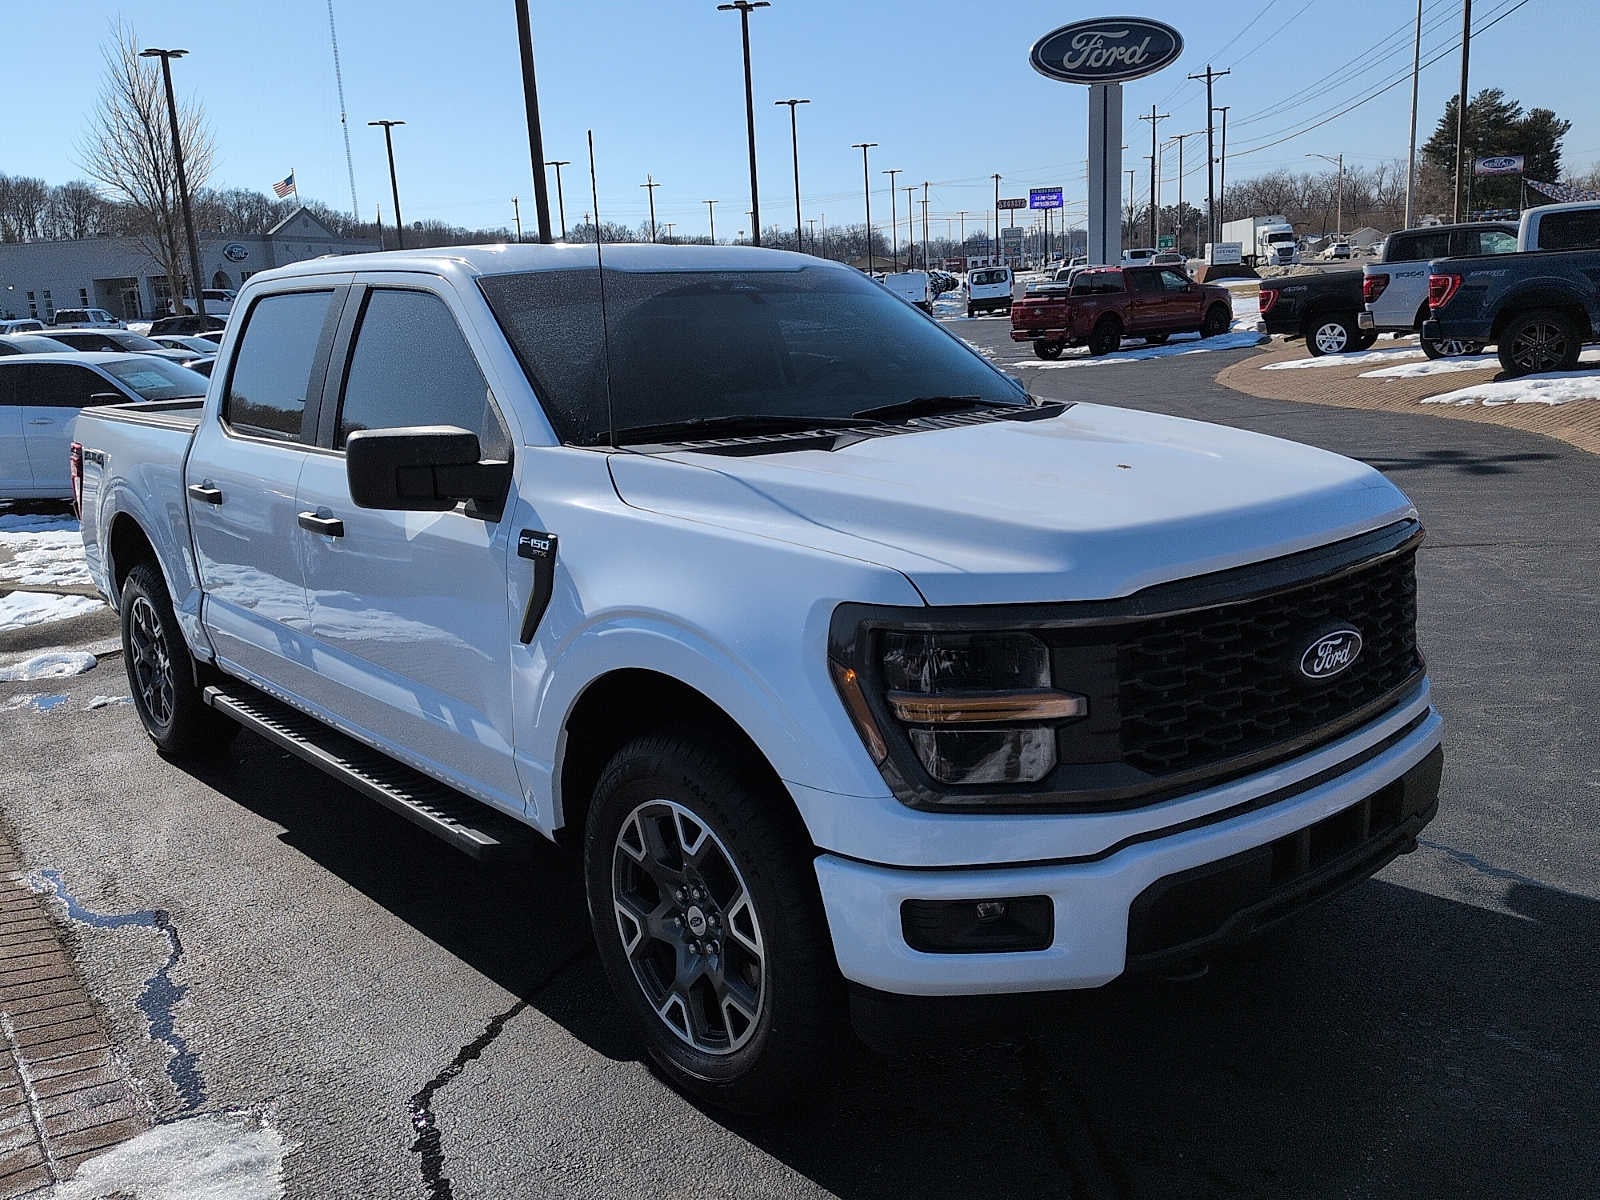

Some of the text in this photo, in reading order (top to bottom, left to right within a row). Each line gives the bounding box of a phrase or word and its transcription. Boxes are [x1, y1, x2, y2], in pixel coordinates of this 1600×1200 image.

[1063, 29, 1151, 69] Ford
[519, 536, 550, 551] F-150
[1313, 637, 1352, 673] Ford
